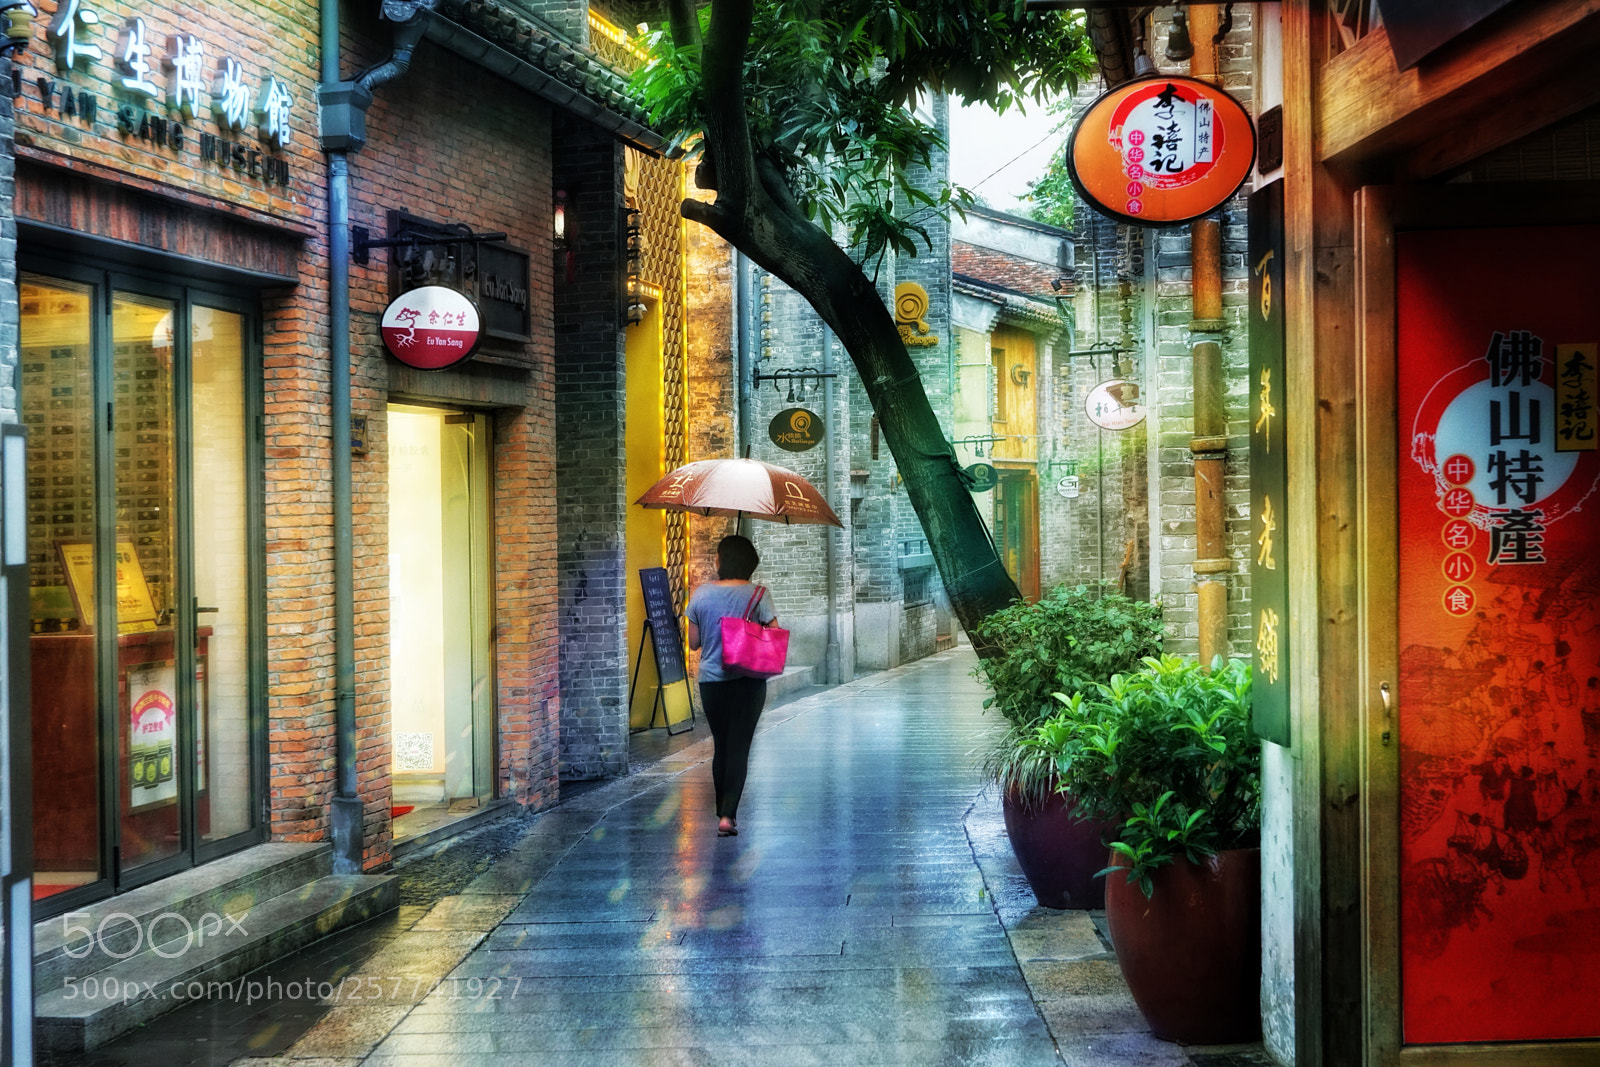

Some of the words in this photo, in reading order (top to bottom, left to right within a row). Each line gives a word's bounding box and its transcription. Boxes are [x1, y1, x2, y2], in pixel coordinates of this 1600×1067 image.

[37, 77, 97, 123] YAN
[117, 103, 184, 150] SANG
[200, 132, 290, 186] MUSEUM
[1198, 101, 1212, 159] 佛山特产
[1127, 130, 1145, 214] 中华名小食
[428, 310, 467, 327] 余仁生
[508, 280, 527, 311] Sang
[427, 336, 435, 345] Eu
[435, 336, 447, 346] Yan
[447, 337, 464, 349] Sang
[1486, 330, 1546, 565] 佛山特產
[1444, 456, 1474, 614] 中华名小食
